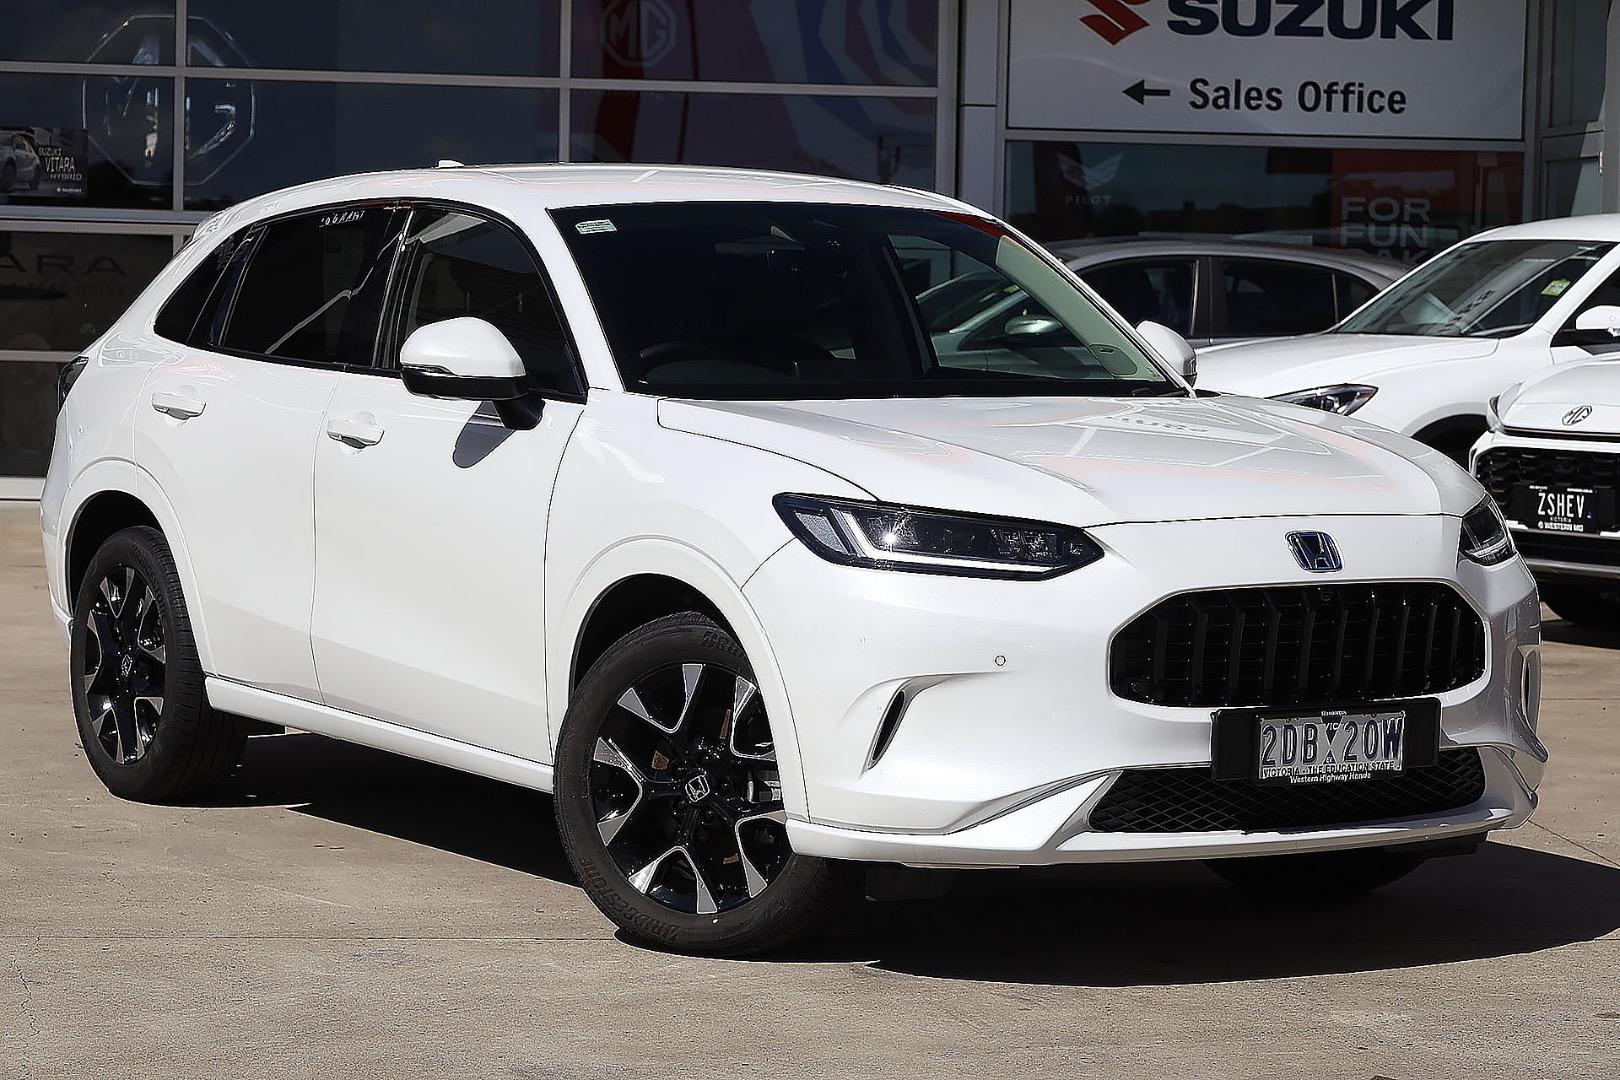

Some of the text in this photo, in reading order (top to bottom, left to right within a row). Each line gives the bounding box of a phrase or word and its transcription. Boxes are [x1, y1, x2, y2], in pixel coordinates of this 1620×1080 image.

[1166, 0, 1454, 40] SUZUKI
[1189, 78, 1407, 114] Sales Office
[45, 157, 75, 172] VITARA
[1064, 195, 1112, 205] PILOT
[1341, 196, 1431, 222] FOR
[1340, 223, 1429, 248] FUN
[1538, 492, 1584, 518] ZSHEV
[1325, 722, 1340, 731] VIC
[1262, 723, 1318, 766] 2DB
[1263, 767, 1300, 778] VICTORIA
[1308, 765, 1323, 774] THE
[1326, 763, 1368, 773] EDUCATION
[1371, 761, 1394, 771] STATE
[1290, 771, 1371, 783] Western Highway Honda
